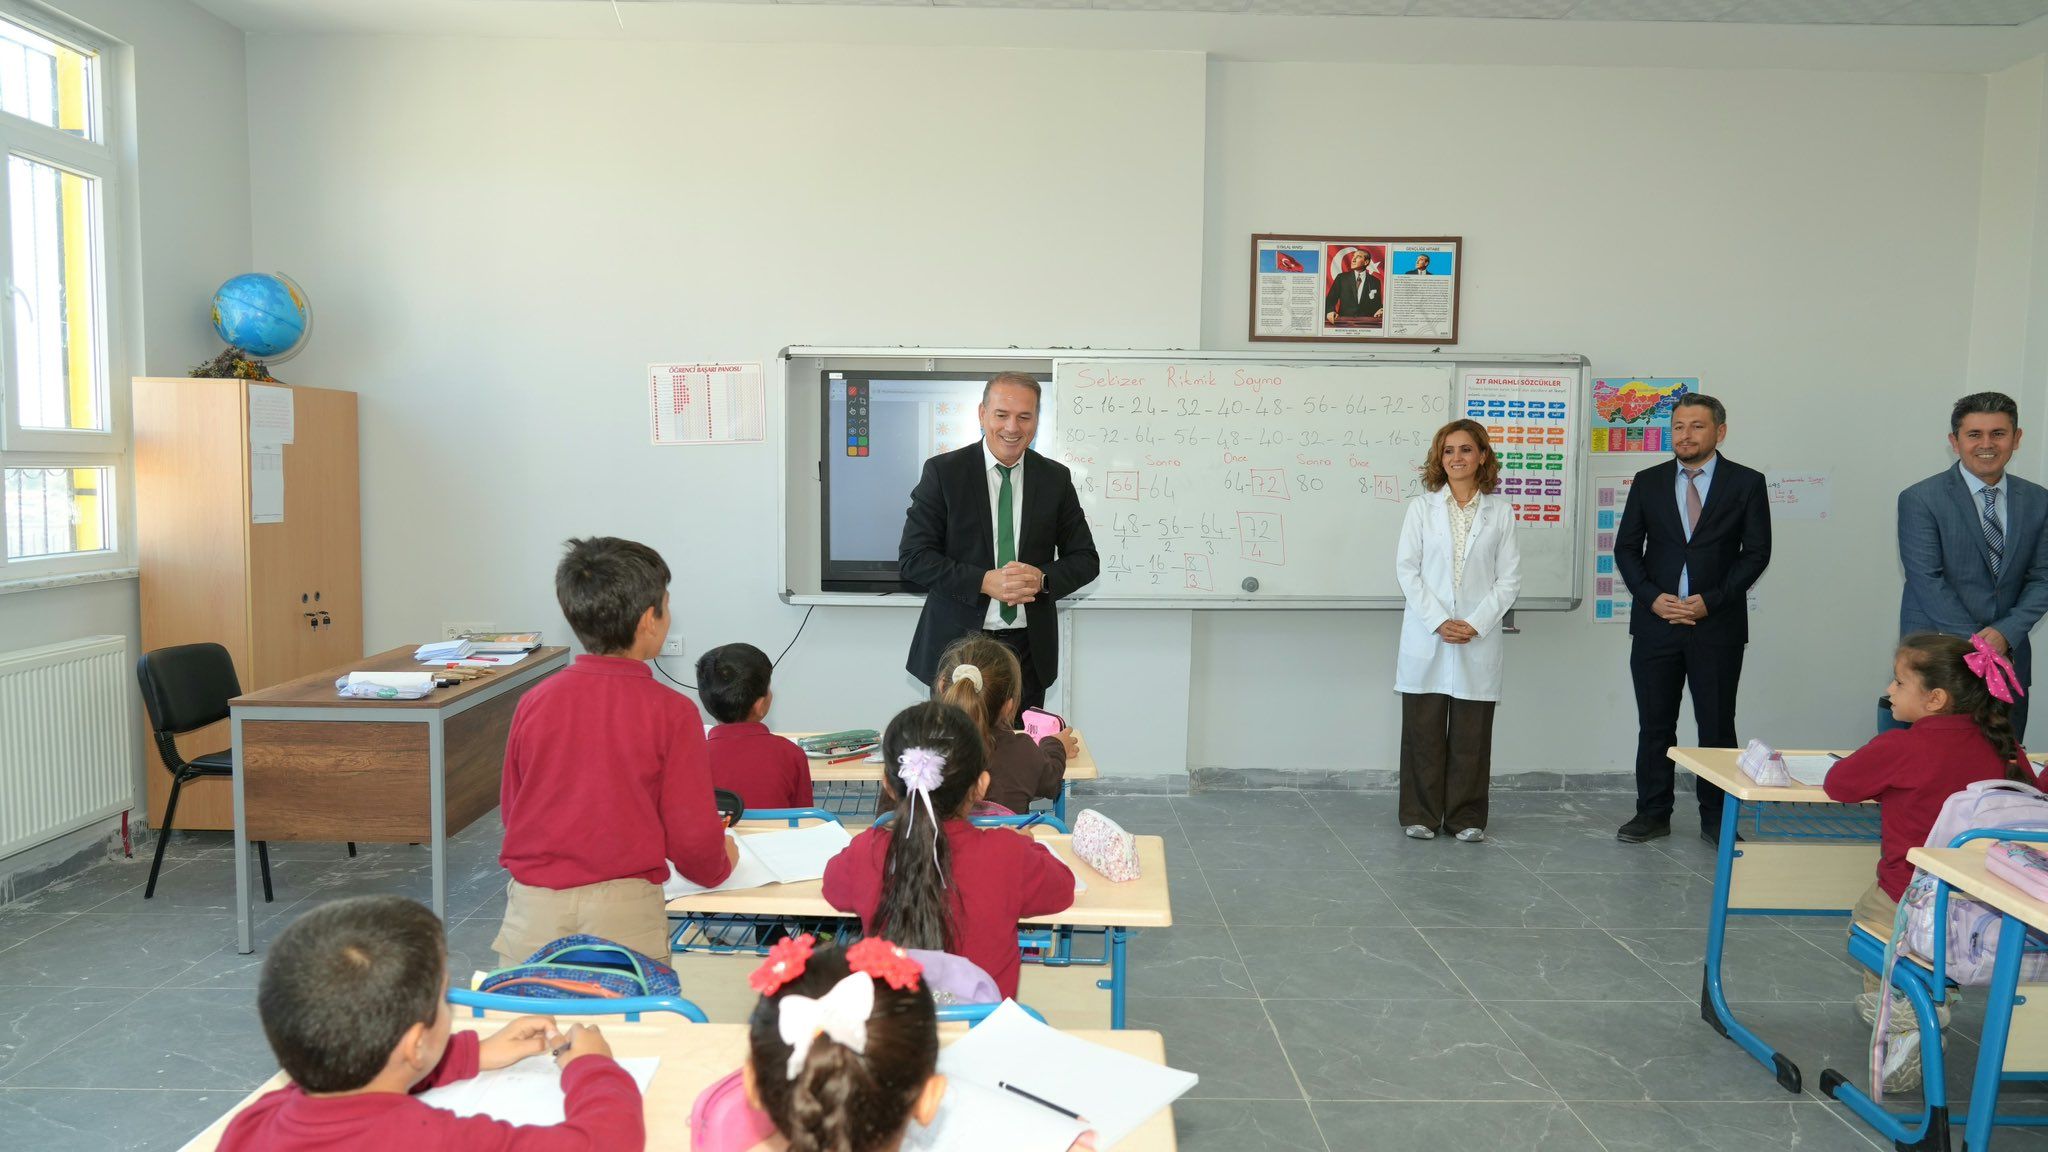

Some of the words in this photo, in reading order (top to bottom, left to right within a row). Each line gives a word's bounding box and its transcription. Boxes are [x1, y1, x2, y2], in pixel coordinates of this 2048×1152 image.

[1074, 368, 1146, 388] Sekizer
[1167, 366, 1217, 388] Ritmik
[1488, 378, 1520, 386] ANLAMLI
[1064, 448, 1096, 466] Önce
[1144, 452, 1182, 468] Sonra
[1223, 446, 1249, 464] Önce
[1296, 452, 1332, 467] Sonra
[1112, 478, 1133, 492] 56
[1296, 474, 1324, 492] 80
[1376, 480, 1392, 494] 16
[1244, 516, 1272, 540] 72
